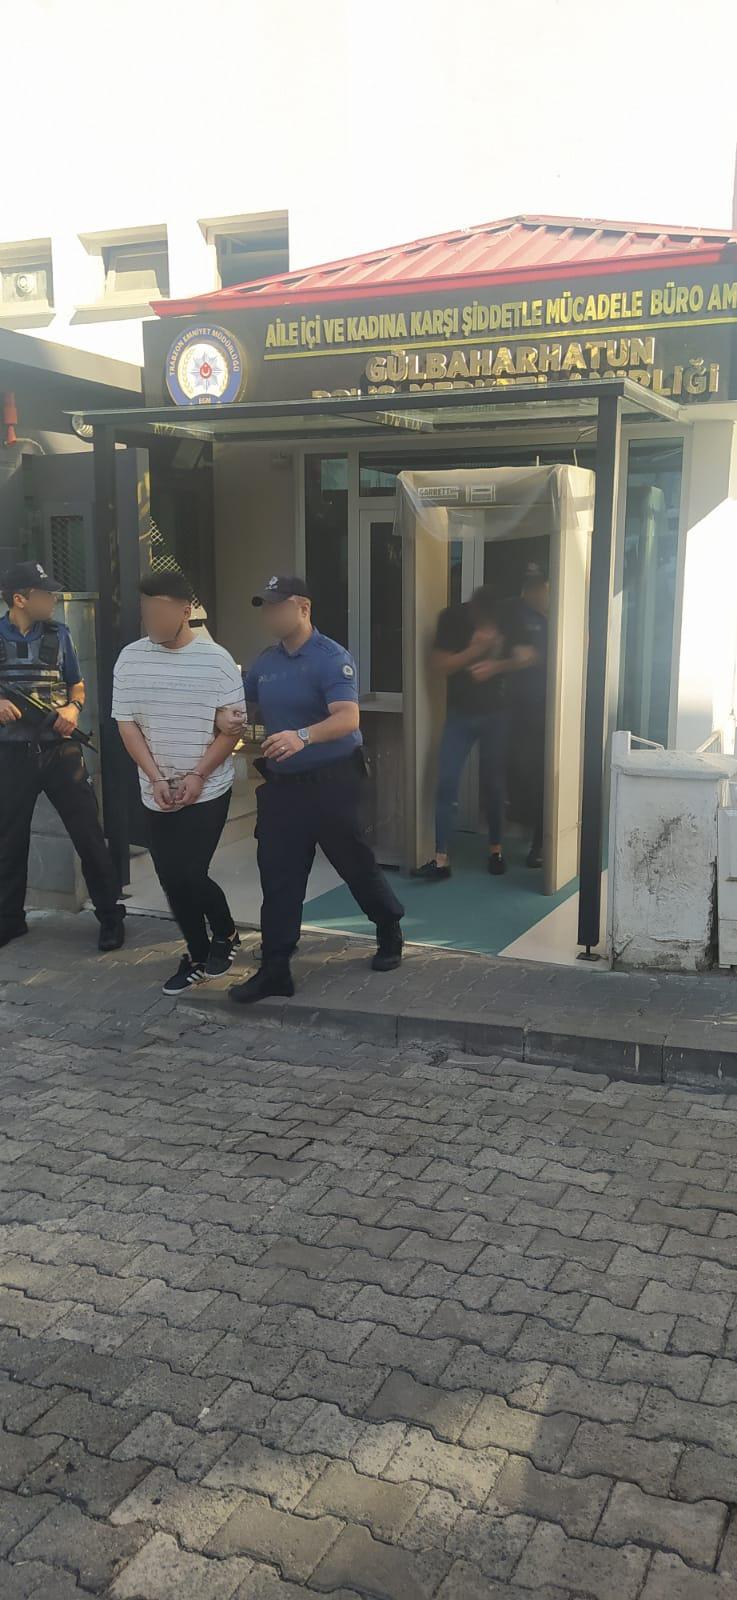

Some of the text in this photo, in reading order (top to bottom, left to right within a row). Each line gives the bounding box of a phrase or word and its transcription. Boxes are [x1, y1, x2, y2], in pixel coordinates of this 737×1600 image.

[265, 318, 298, 347] AİLE
[301, 315, 321, 349] İÇİ
[323, 318, 345, 343] VE
[347, 312, 407, 341] KADINA
[410, 307, 459, 337] KARŞI
[462, 299, 543, 337] ŞİDDETLE
[546, 290, 643, 325] MÜCADELE
[650, 282, 704, 316] BÜRO
[365, 337, 655, 382] GÜLBAHARHATUN
